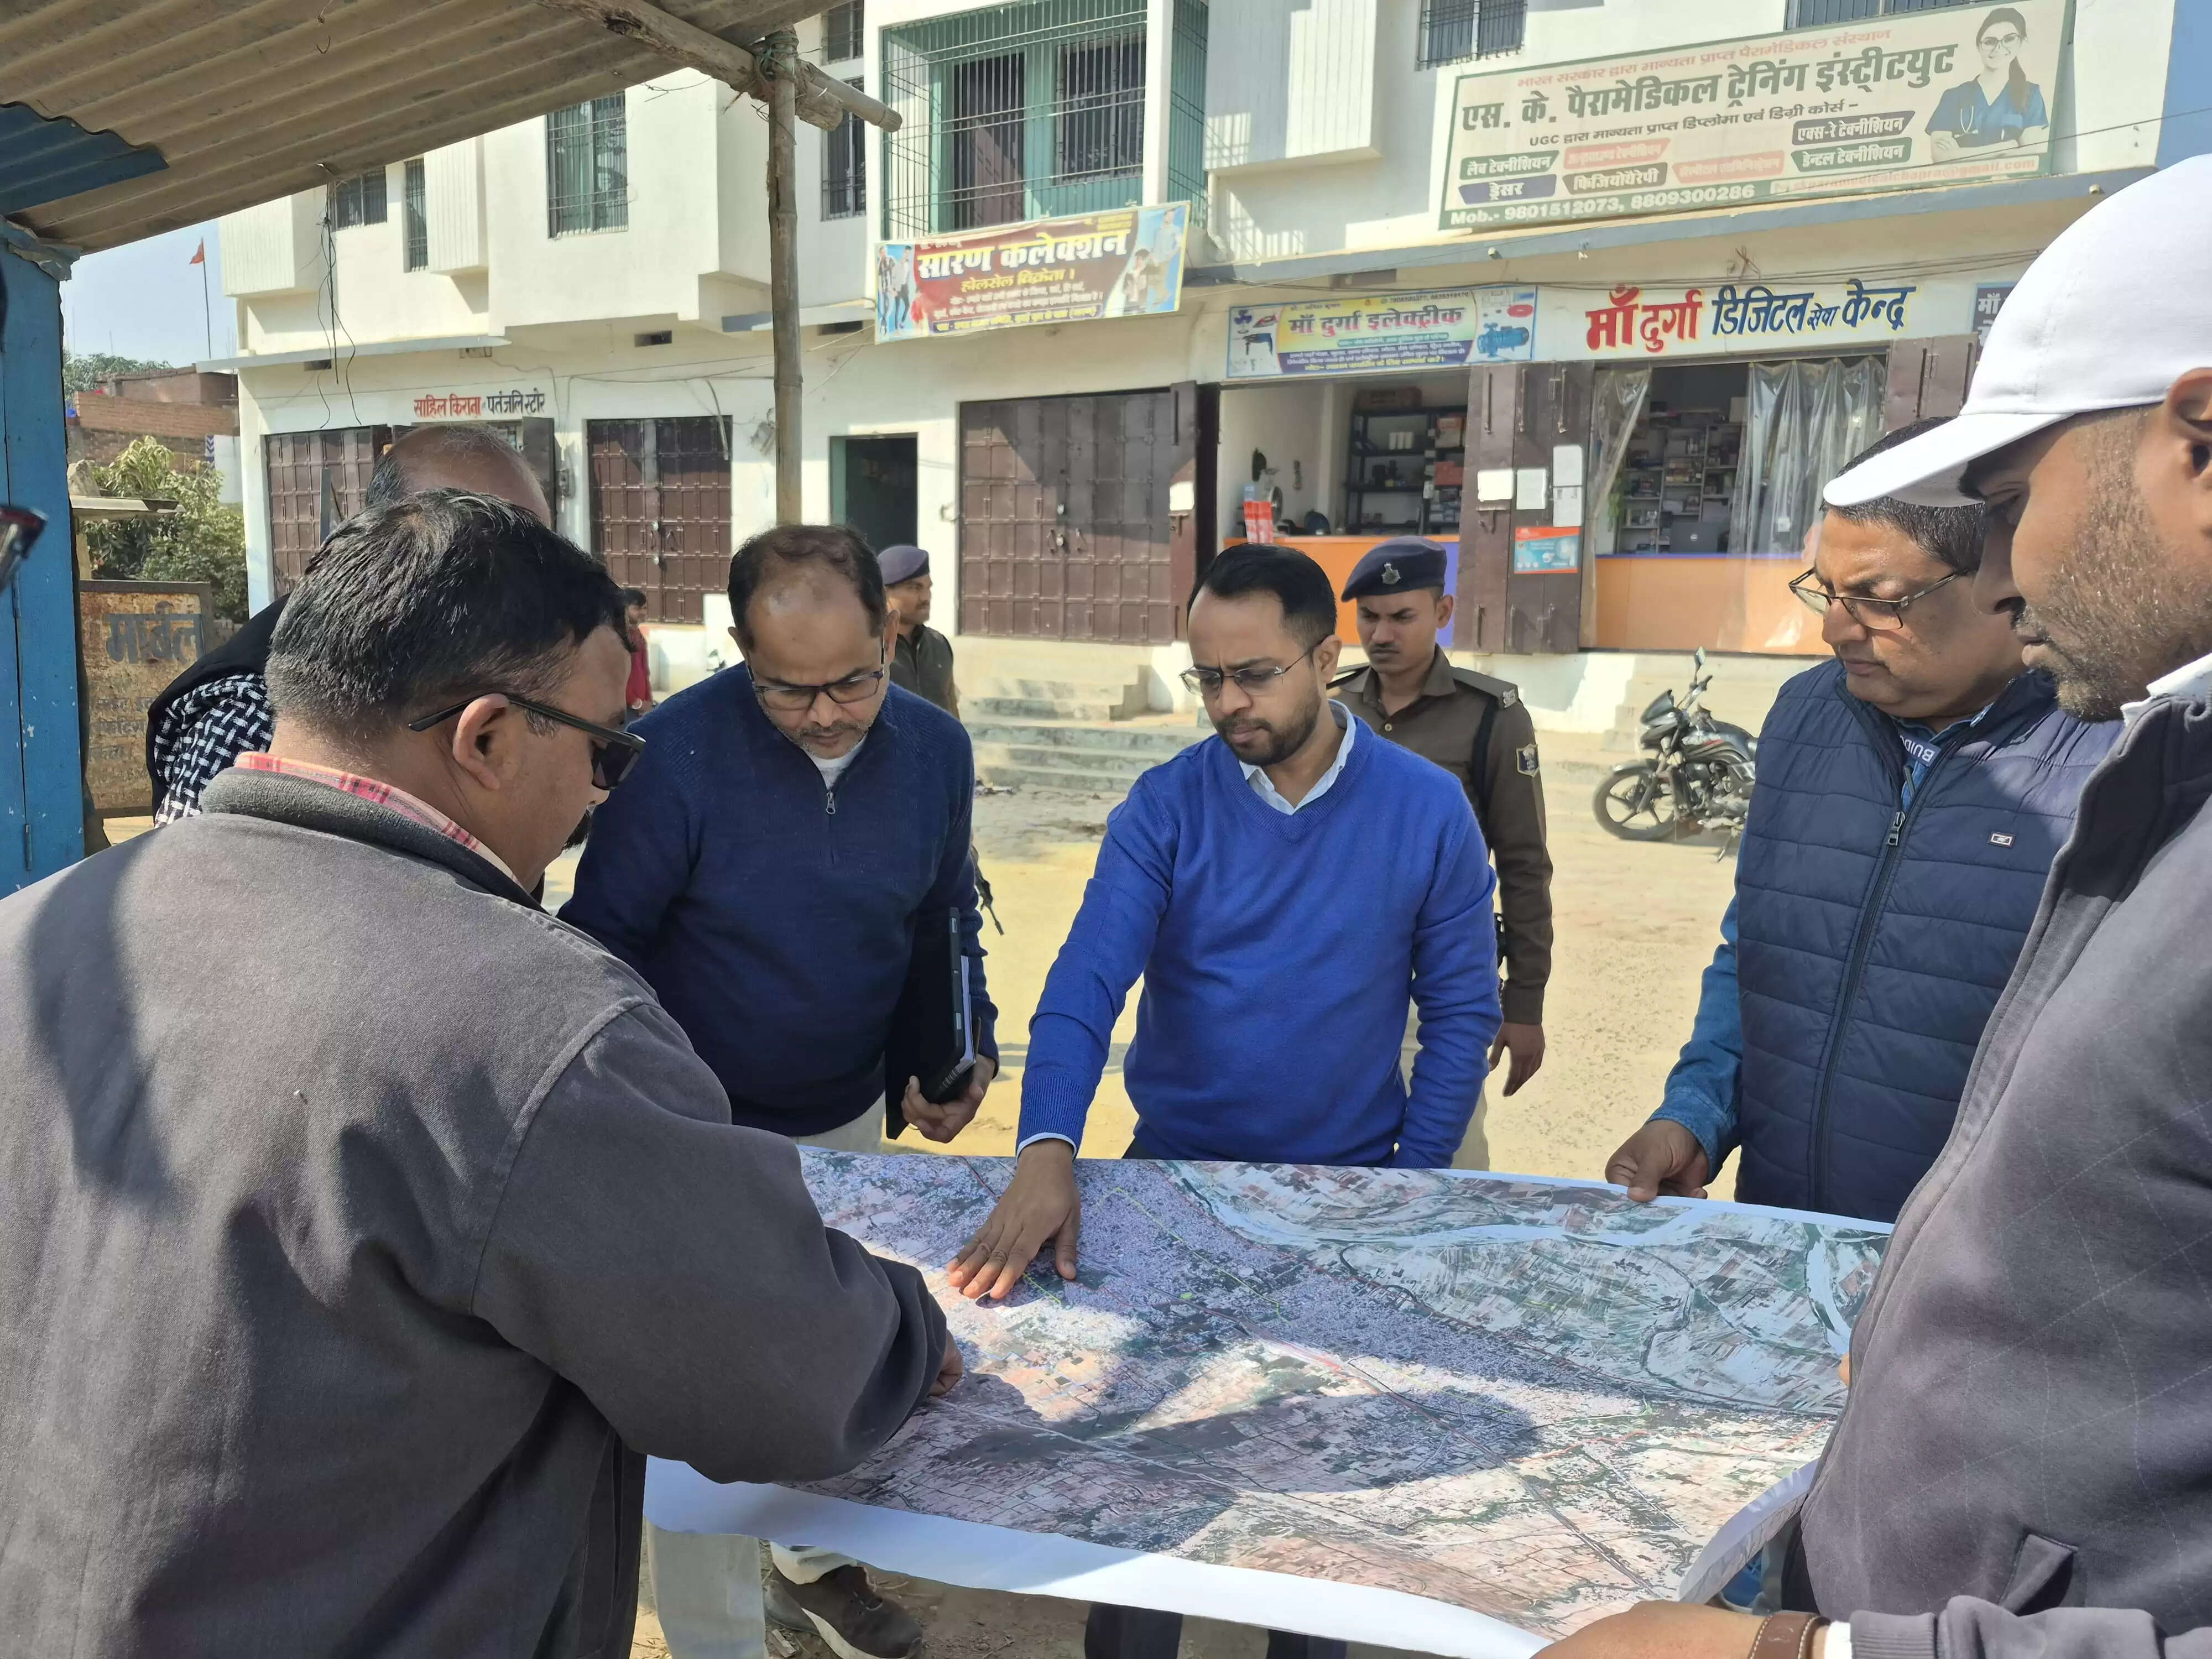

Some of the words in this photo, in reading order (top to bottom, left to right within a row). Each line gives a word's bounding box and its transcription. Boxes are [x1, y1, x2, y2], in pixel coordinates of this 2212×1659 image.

[1517, 75, 1553, 87] भारत
[1557, 69, 1606, 82] सरकार
[1609, 64, 1637, 77] द्वारा
[1641, 56, 1697, 71] मान्यता
[1700, 50, 1736, 65] प्राप्त
[1832, 30, 1892, 46] संस्थान
[1462, 103, 1511, 131] एस.
[1522, 91, 1557, 123] के.
[1566, 75, 1722, 118] पैरामेडिकल
[1727, 59, 1809, 108] ट्रेनिंग
[1530, 134, 1559, 147] UGC
[1563, 132, 1589, 144] द्वारा
[1593, 126, 1643, 139] मान्यता
[1646, 121, 1679, 135] प्राप्त
[1683, 113, 1739, 130] डिप्लोमा
[1743, 108, 1765, 123] एवं
[1769, 104, 1805, 119] डिग्री
[1808, 98, 1845, 114] कोर्स
[1797, 121, 1837, 142] एक्स-रे
[1838, 117, 1905, 137] टेक्नीशियन
[1802, 151, 1836, 168] डेन्टल
[1837, 144, 1905, 164] टेक्नीशियन
[1489, 181, 1525, 201] ड्रेसर
[1504, 196, 1624, 221] 9801512073,
[1631, 184, 1755, 210] 8809300286
[917, 247, 995, 279] सारण
[999, 229, 1130, 268] कलेक्शन
[1320, 311, 1361, 337] दुर्गा
[1641, 289, 1703, 353] दुर्गा
[1712, 285, 1814, 335] डिजिटल
[1806, 303, 1840, 330] सेवा
[1842, 279, 1917, 330] केन्द्र
[414, 394, 447, 418] साहिल
[486, 390, 523, 414] पतंजलि
[524, 388, 545, 414] स्टोर
